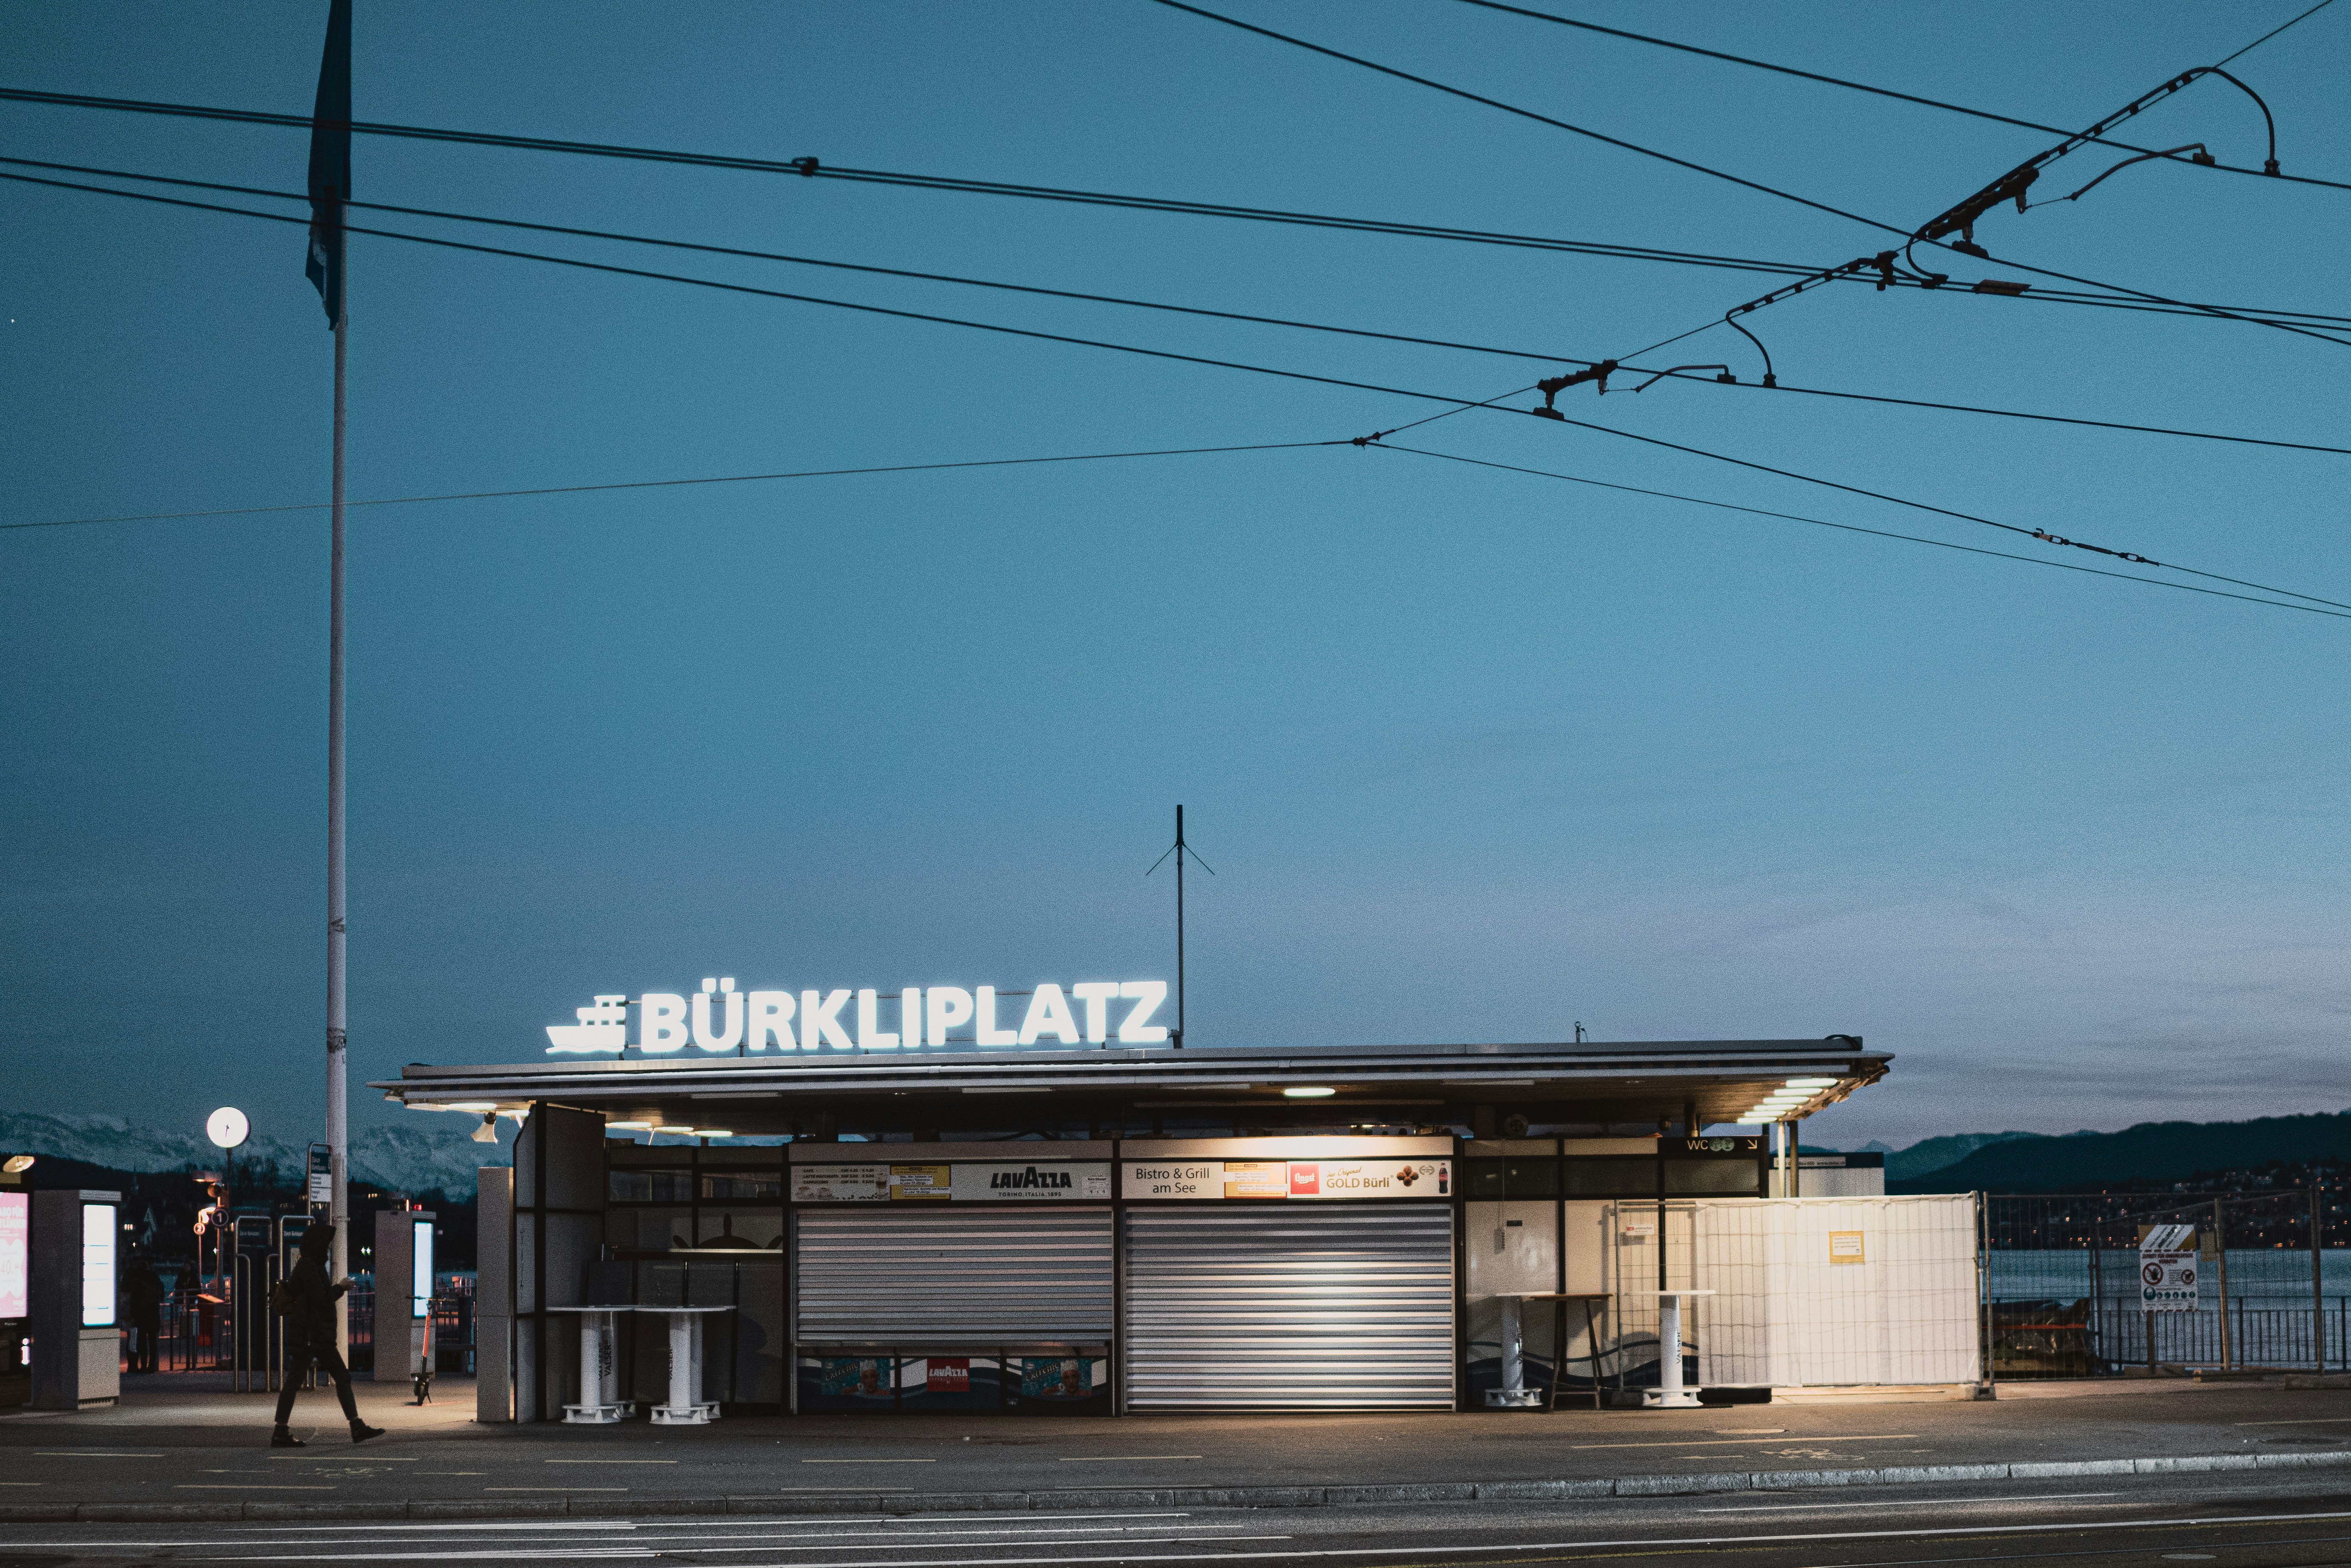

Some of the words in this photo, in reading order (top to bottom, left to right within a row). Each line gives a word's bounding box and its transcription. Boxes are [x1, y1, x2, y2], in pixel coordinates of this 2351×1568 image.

[640, 977, 1168, 1054] BÜRKLIPLATZ
[1687, 1140, 1709, 1150] WC
[1136, 1168, 1170, 1179] Bistro
[1173, 1168, 1183, 1179] &
[1186, 1167, 1209, 1178] Grill
[1338, 1166, 1362, 1177] Original
[990, 1167, 1072, 1189] LAVAZZA
[1327, 1178, 1360, 1188] GOLD
[1363, 1177, 1390, 1188] Bürli
[1153, 1185, 1171, 1193] am
[1175, 1182, 1196, 1193] See
[217, 1212, 222, 1223] 1
[197, 1225, 202, 1233] 2
[929, 1366, 968, 1377] LAVAZZA
